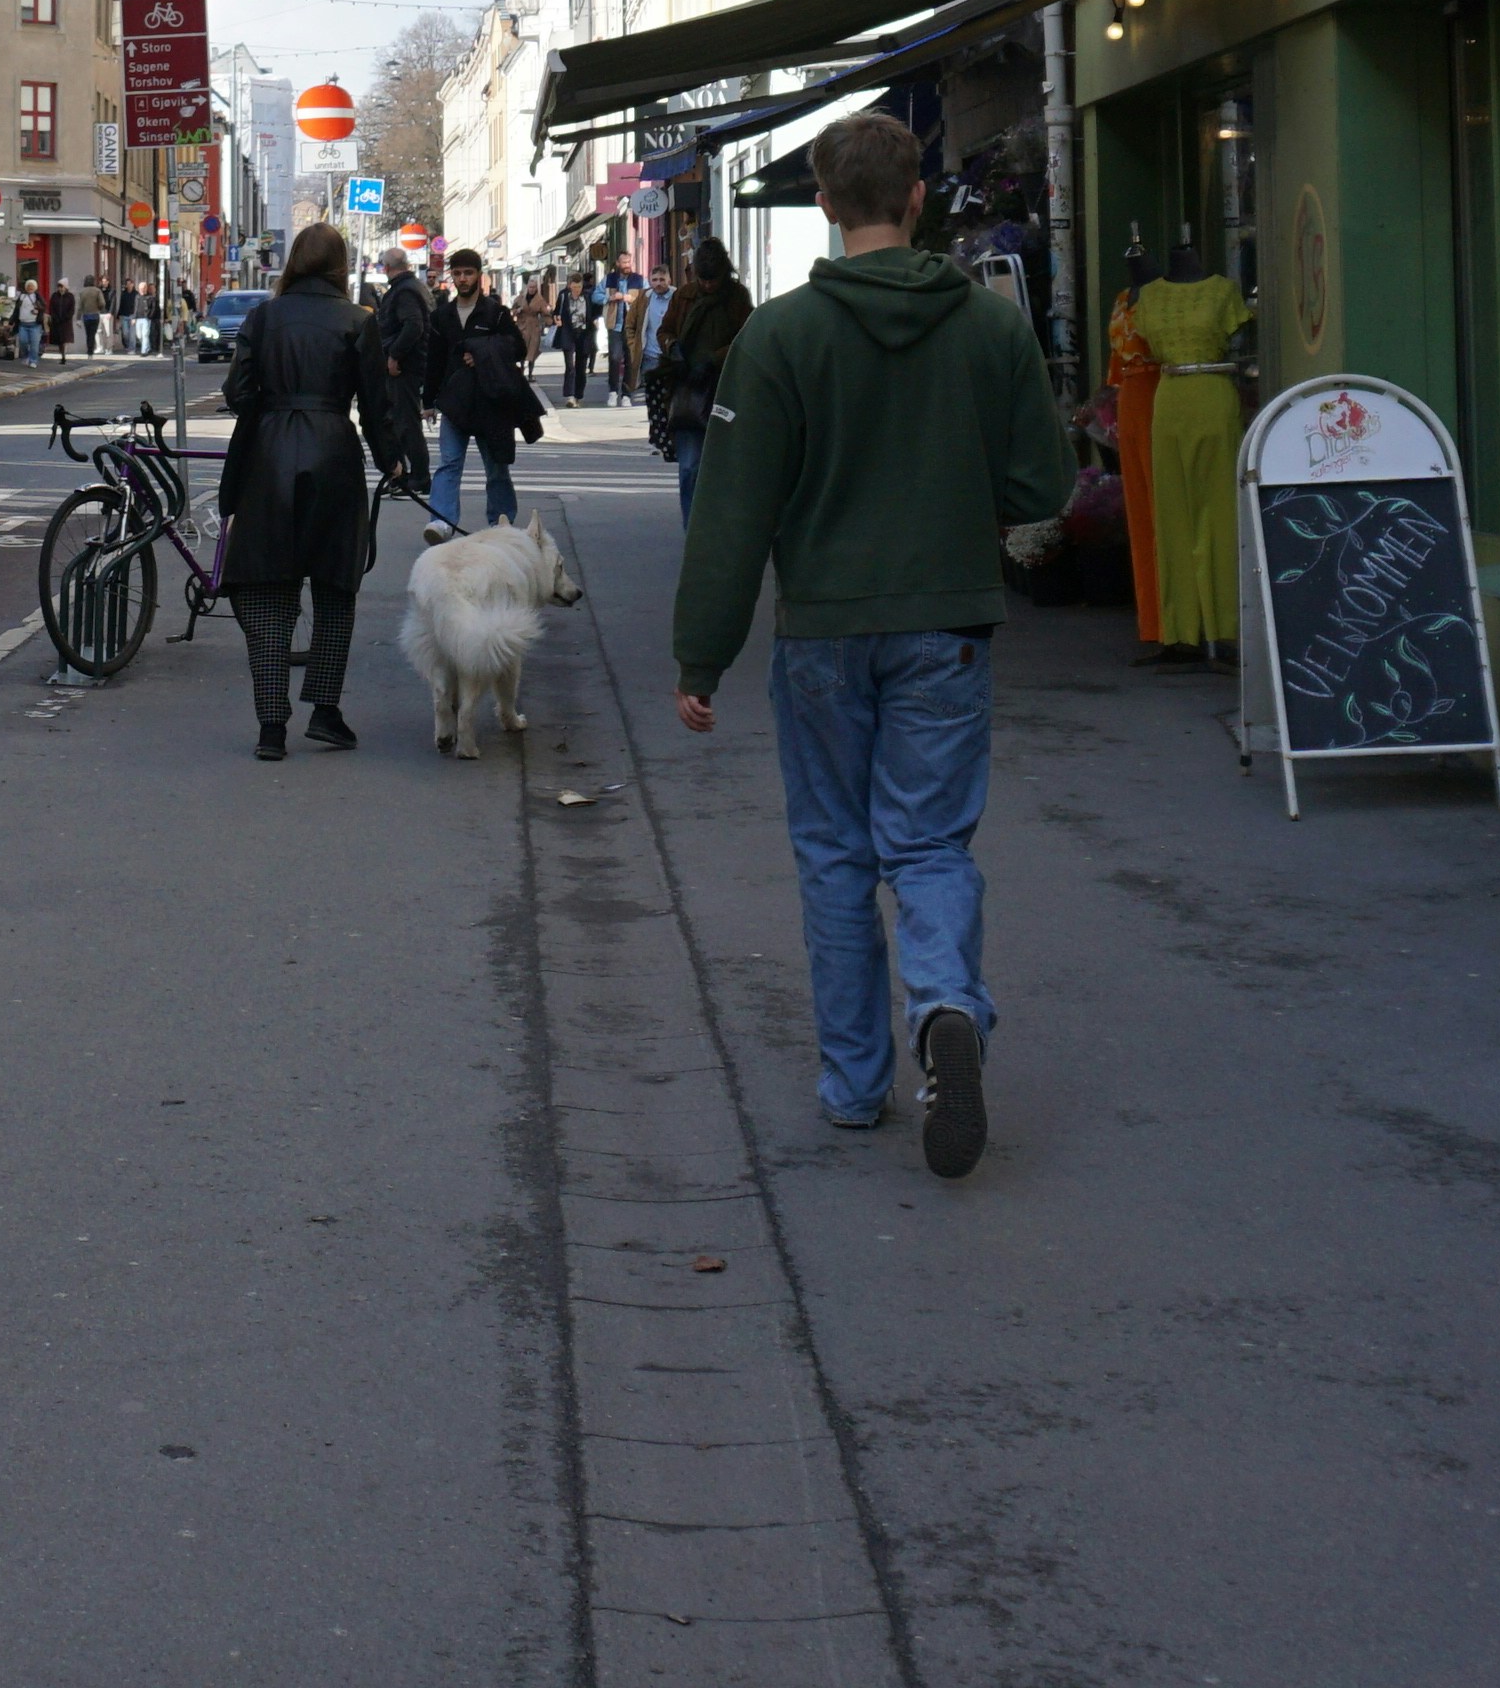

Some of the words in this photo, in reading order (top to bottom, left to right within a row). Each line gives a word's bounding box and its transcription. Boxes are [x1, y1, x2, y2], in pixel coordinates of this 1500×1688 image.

[141, 42, 172, 53] Storo
[128, 62, 170, 75] Sagene
[128, 76, 173, 88] Torshov
[151, 95, 187, 109] Gjøvik
[680, 90, 727, 109] NOA
[136, 116, 171, 128] Økern
[138, 131, 177, 143] Sinsen
[644, 131, 683, 150] NOA
[104, 125, 117, 174] GANNI
[314, 161, 345, 170] unntatt
[1286, 517, 1450, 698] VELKOMMEN
